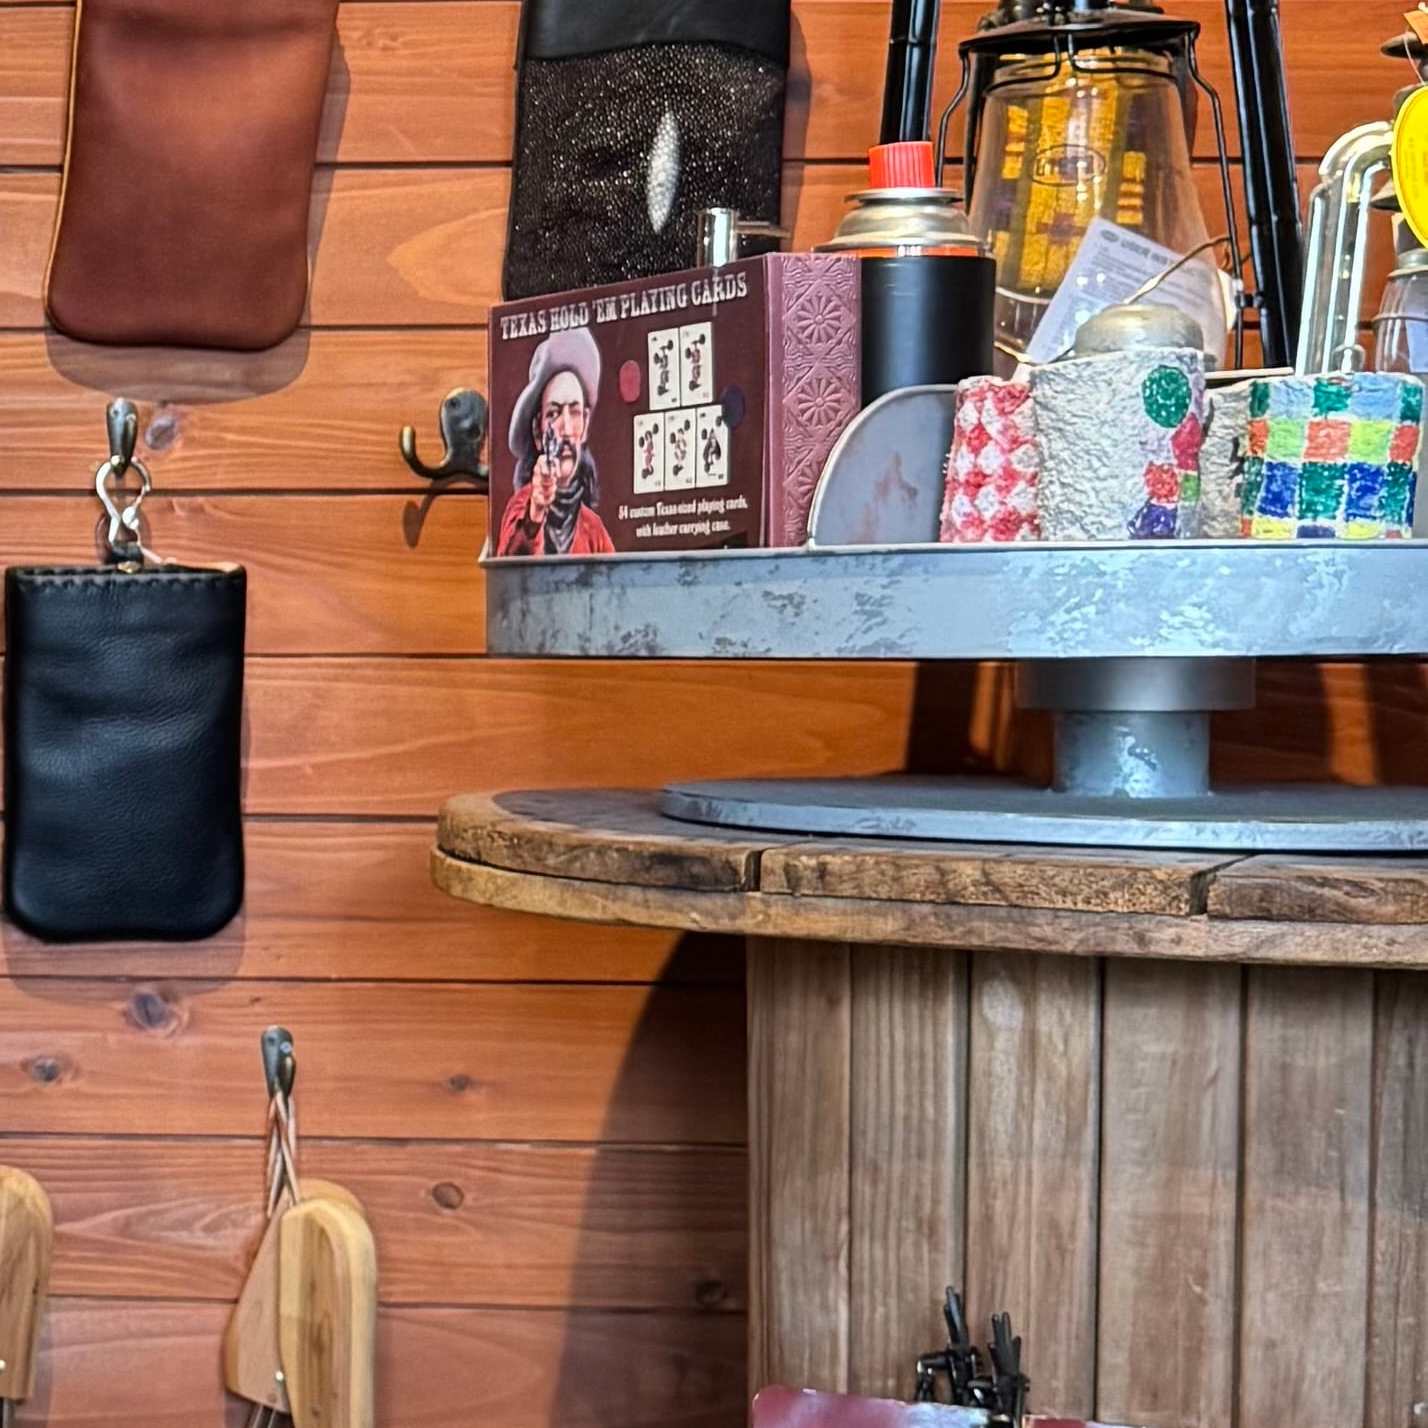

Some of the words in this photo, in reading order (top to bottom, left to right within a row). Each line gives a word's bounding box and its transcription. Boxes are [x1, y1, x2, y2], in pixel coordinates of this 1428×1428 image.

[501, 310, 546, 340] TEXAS
[550, 301, 589, 331] HOLD
[593, 295, 617, 323] 'EM
[621, 283, 687, 318] PLAYING
[691, 272, 748, 306] CARDS
[697, 497, 725, 516] playing
[636, 523, 651, 538] with
[652, 522, 678, 537] leather
[679, 519, 710, 536] carrying
